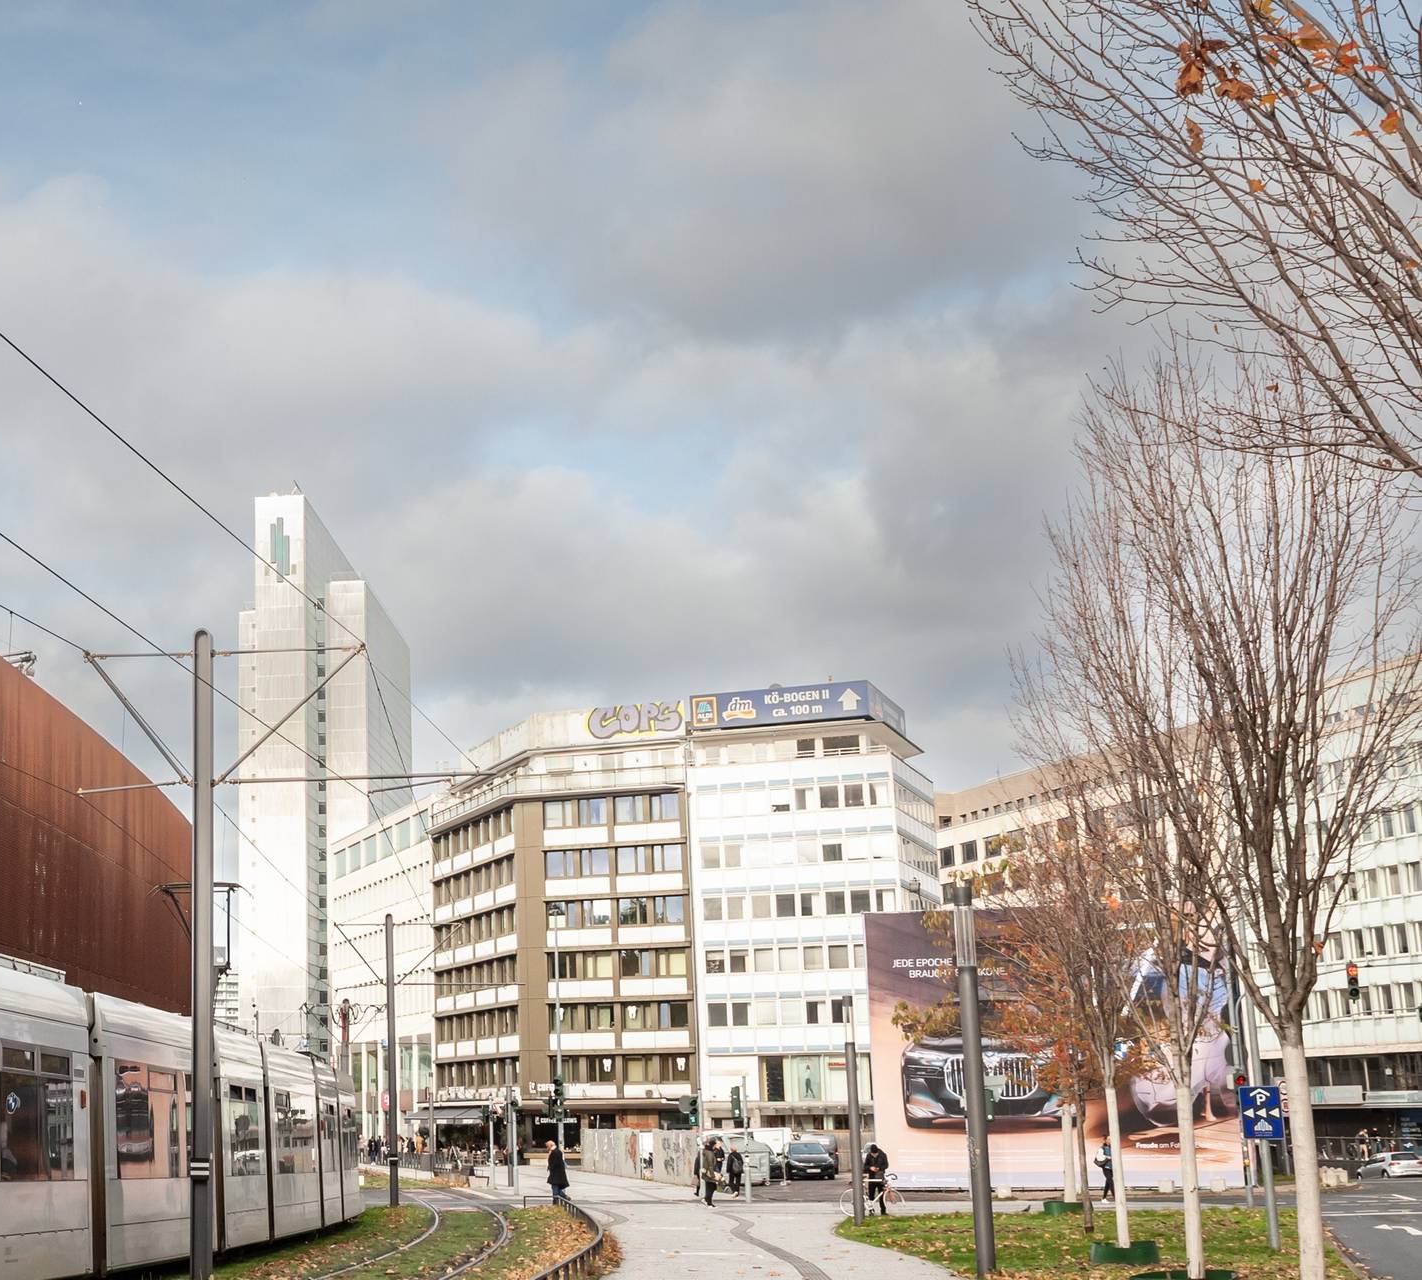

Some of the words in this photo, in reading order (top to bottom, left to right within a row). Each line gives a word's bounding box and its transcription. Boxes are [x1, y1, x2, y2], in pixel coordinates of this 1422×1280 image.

[764, 690, 820, 704] KÖ-BOGEN
[727, 697, 753, 712] dm
[772, 708, 788, 717] ca.
[790, 705, 810, 715] 100
[812, 705, 823, 713] m
[588, 700, 682, 739] COPS
[893, 959, 916, 968] JEDE
[916, 958, 953, 967] EPOCHE
[1256, 1093, 1266, 1106] P
